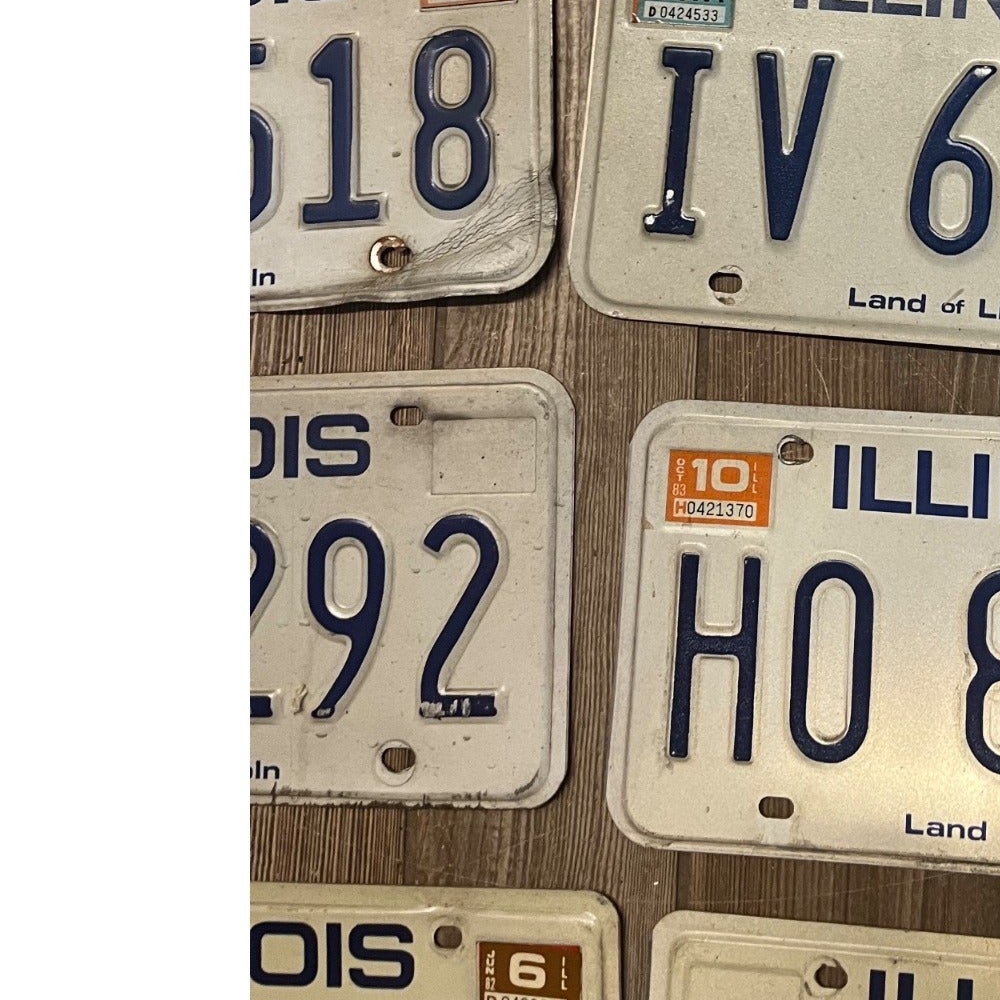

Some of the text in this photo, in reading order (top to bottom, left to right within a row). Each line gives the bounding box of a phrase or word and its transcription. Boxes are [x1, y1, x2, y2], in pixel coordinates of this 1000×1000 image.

[644, 46, 835, 241] IV
[849, 287, 927, 313] Land
[941, 299, 965, 314] of
[672, 458, 686, 497] OCT 83
[691, 458, 750, 493] 10
[905, 813, 987, 841] Land
[509, 952, 546, 989] 6
